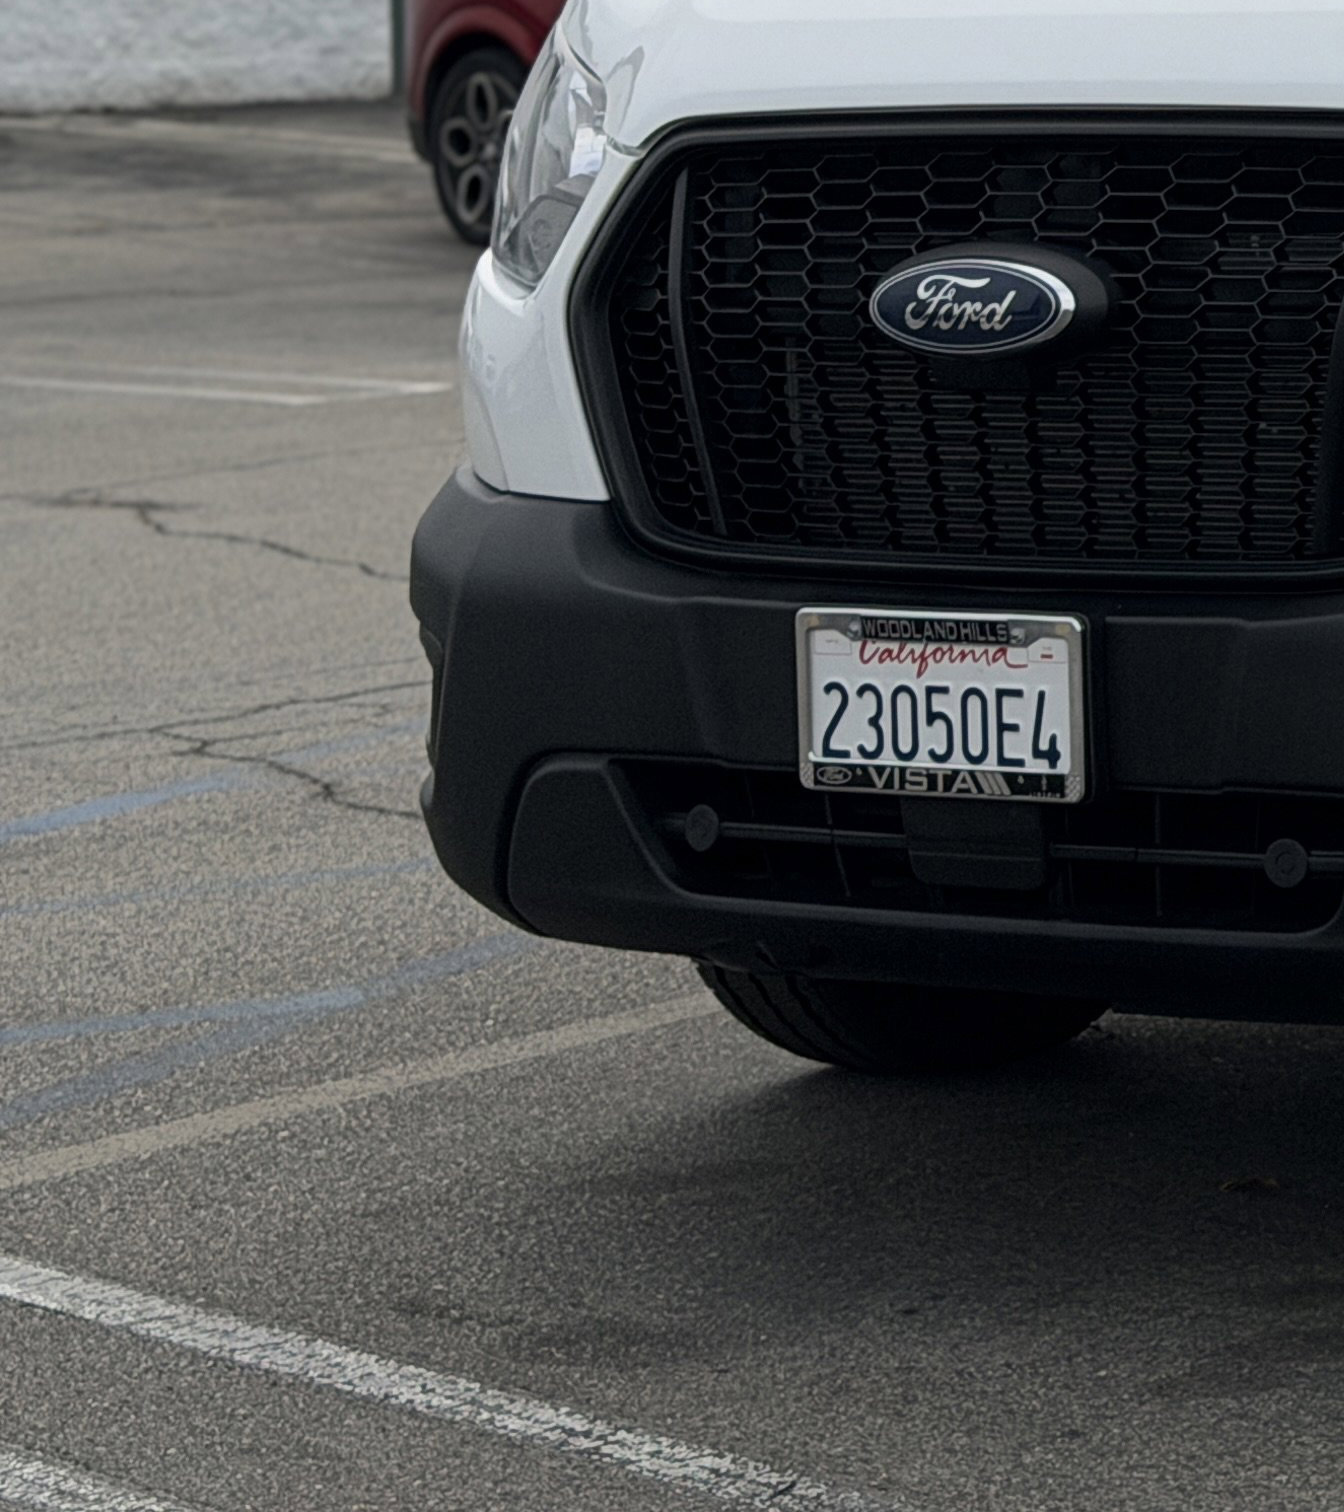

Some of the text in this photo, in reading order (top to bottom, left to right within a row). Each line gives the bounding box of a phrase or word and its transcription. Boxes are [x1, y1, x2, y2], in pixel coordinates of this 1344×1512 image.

[904, 274, 1017, 331] Ford
[859, 639, 1028, 679] California
[822, 681, 1061, 770] 23050E4
[867, 766, 979, 794] VISTA
